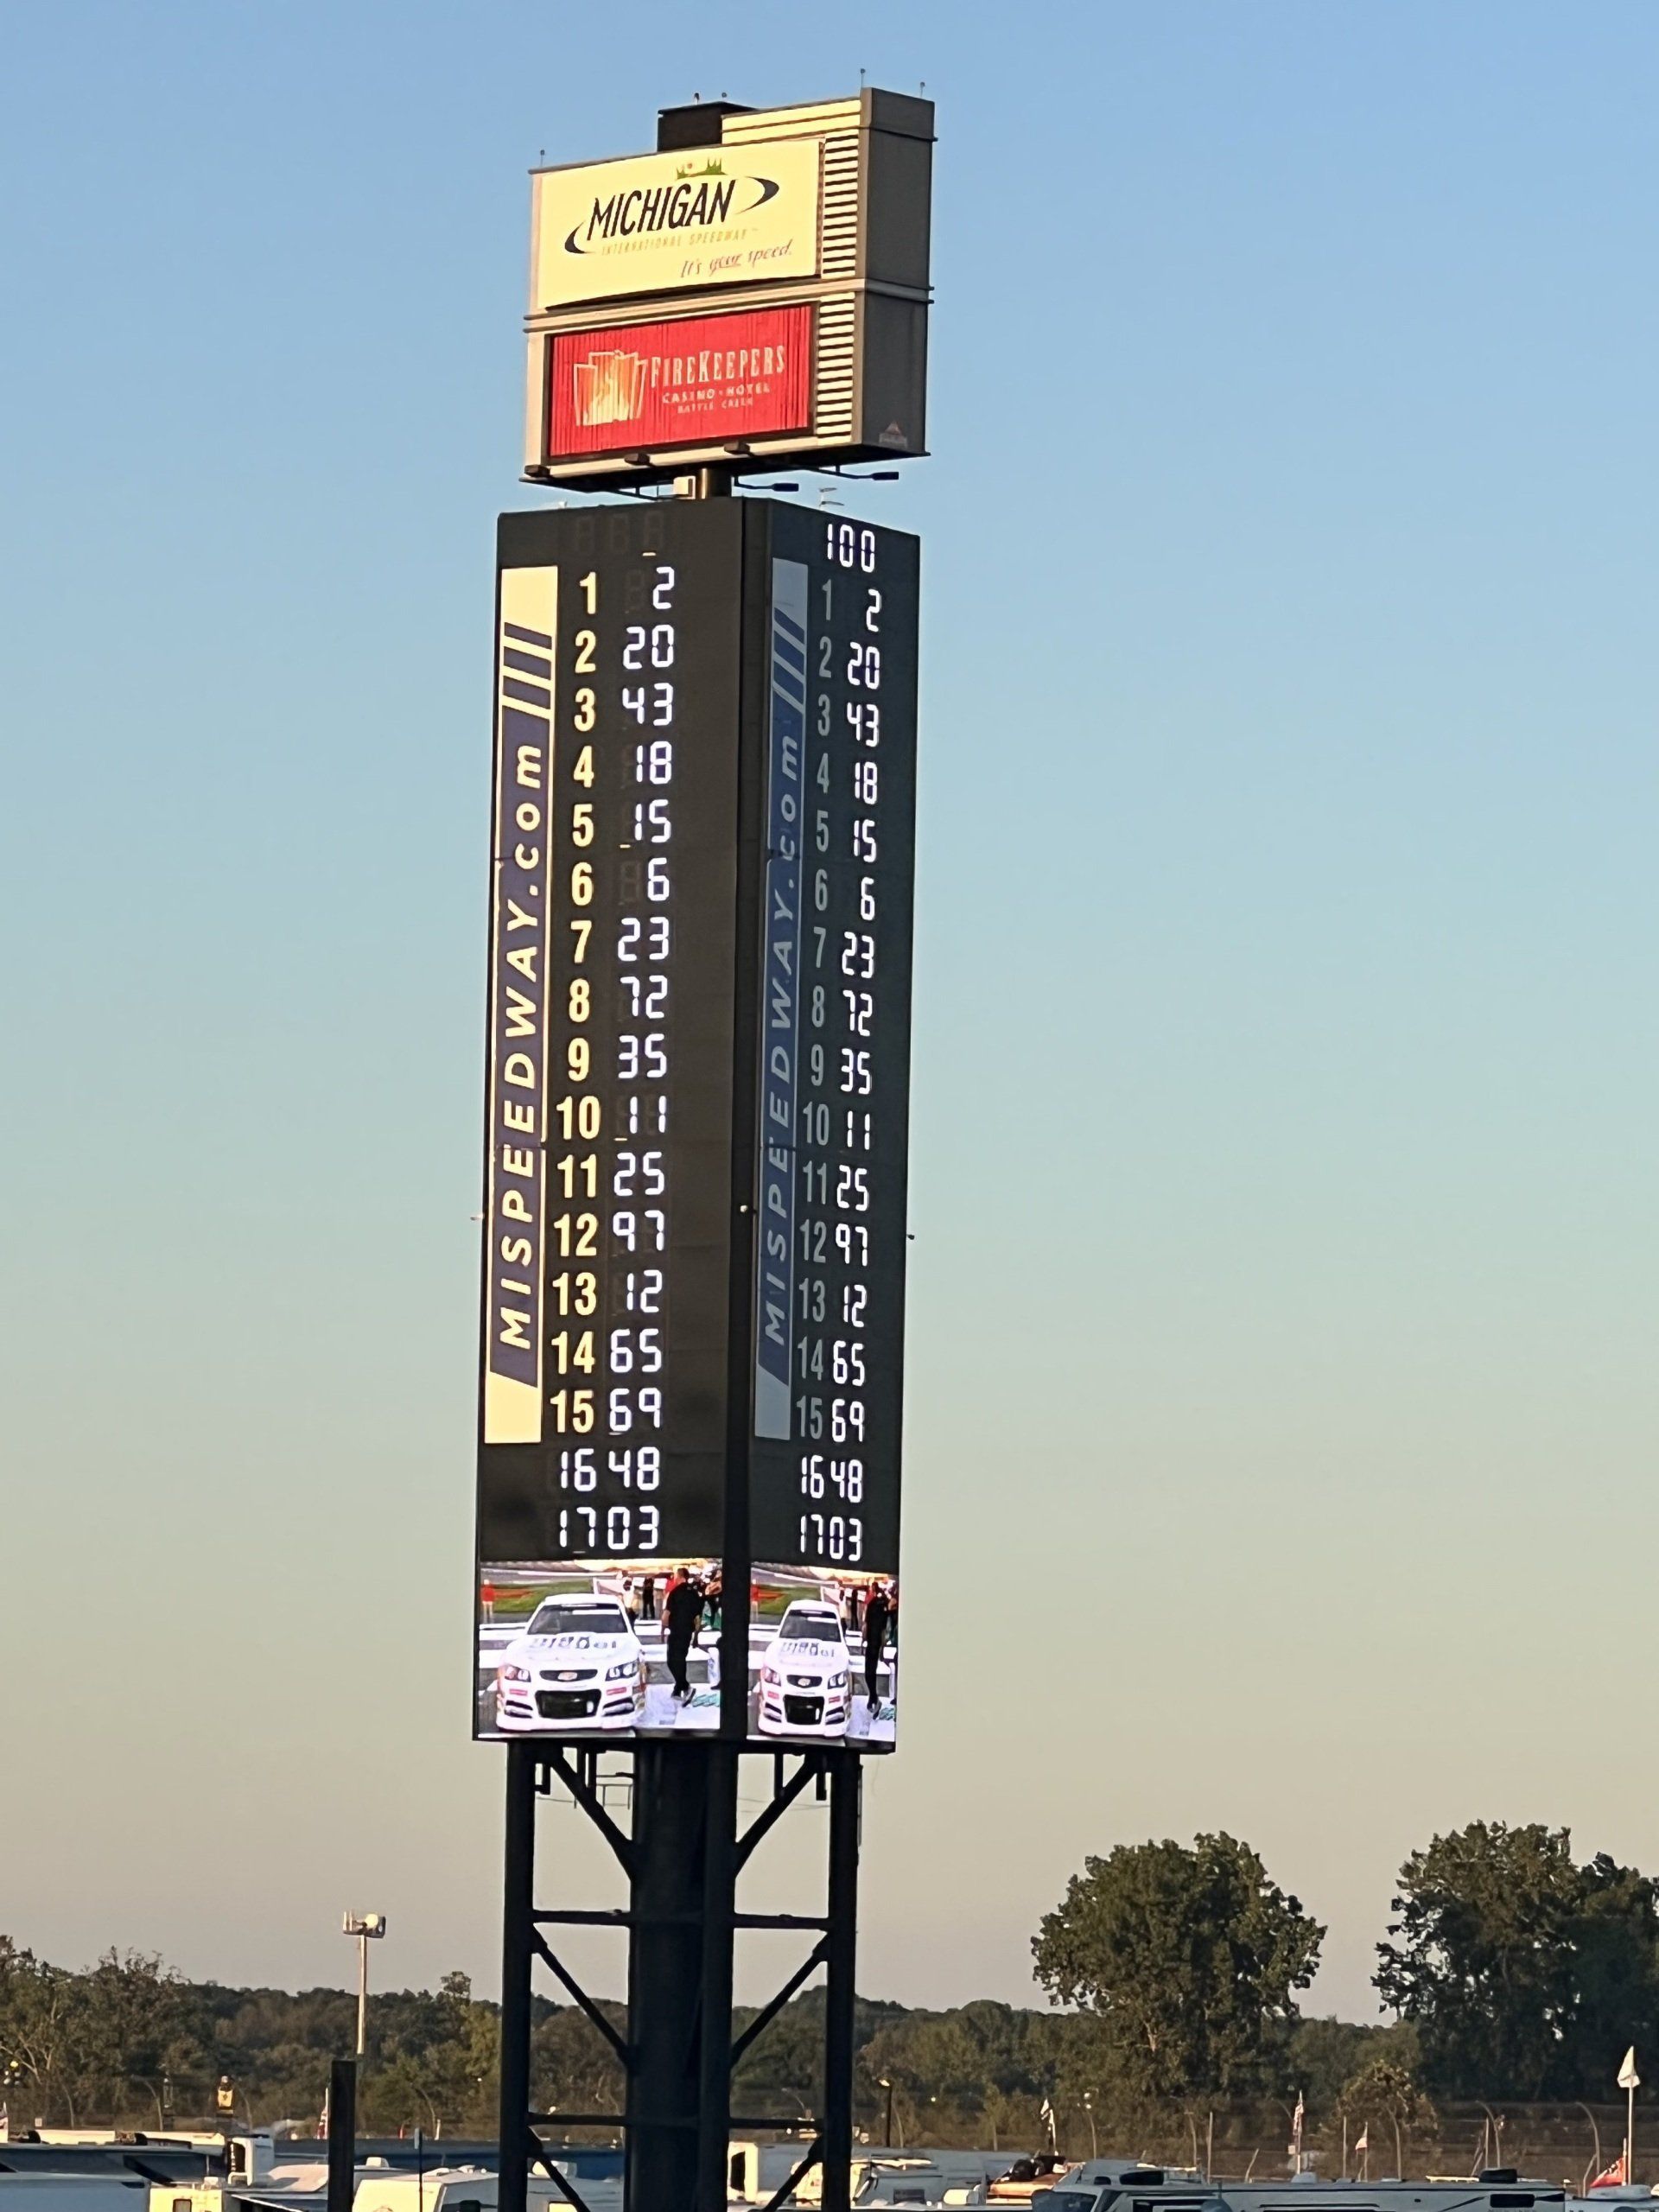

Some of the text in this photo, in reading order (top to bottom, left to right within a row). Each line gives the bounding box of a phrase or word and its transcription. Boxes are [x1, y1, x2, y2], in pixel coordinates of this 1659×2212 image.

[587, 179, 735, 240] MICHIGAN
[601, 229, 746, 255] INTERNATIONAL SPEEDWAY
[681, 238, 792, 277] It's your speed.
[662, 383, 770, 404] CASINO HOTEL
[677, 403, 714, 414] BATTLE
[828, 524, 875, 572] 100
[580, 567, 674, 613] 1 2
[823, 579, 880, 632] 1 2
[575, 625, 674, 673] 2 20
[819, 636, 880, 689] 2 20
[575, 683, 673, 731] 3 43
[818, 694, 879, 747] 3 43
[574, 741, 671, 787] 4 18
[817, 753, 877, 804] 4 18
[573, 799, 671, 847] 5 15
[817, 810, 876, 862] 5 15
[572, 858, 669, 906] 6 6
[816, 869, 874, 920] 6 6
[571, 917, 669, 963] 7 23
[814, 926, 874, 978] 7 23
[569, 976, 667, 1022] 8 72
[812, 986, 872, 1036] 8 72
[569, 1033, 666, 1081] 9 35
[811, 1045, 870, 1094] 9 35
[556, 1096, 666, 1140] 10 11
[803, 1102, 870, 1149] 10 11
[557, 1152, 664, 1198] 11 25
[803, 1160, 868, 1211] 11 25
[554, 1211, 664, 1256] 12 97
[800, 1219, 868, 1266] 12 97
[553, 1270, 662, 1315] 13 12
[799, 1278, 867, 1327] 13 12
[551, 1329, 661, 1374] 14 65
[798, 1337, 864, 1386] 14 65
[550, 1388, 661, 1433] 15 69
[797, 1395, 864, 1442] 15 69
